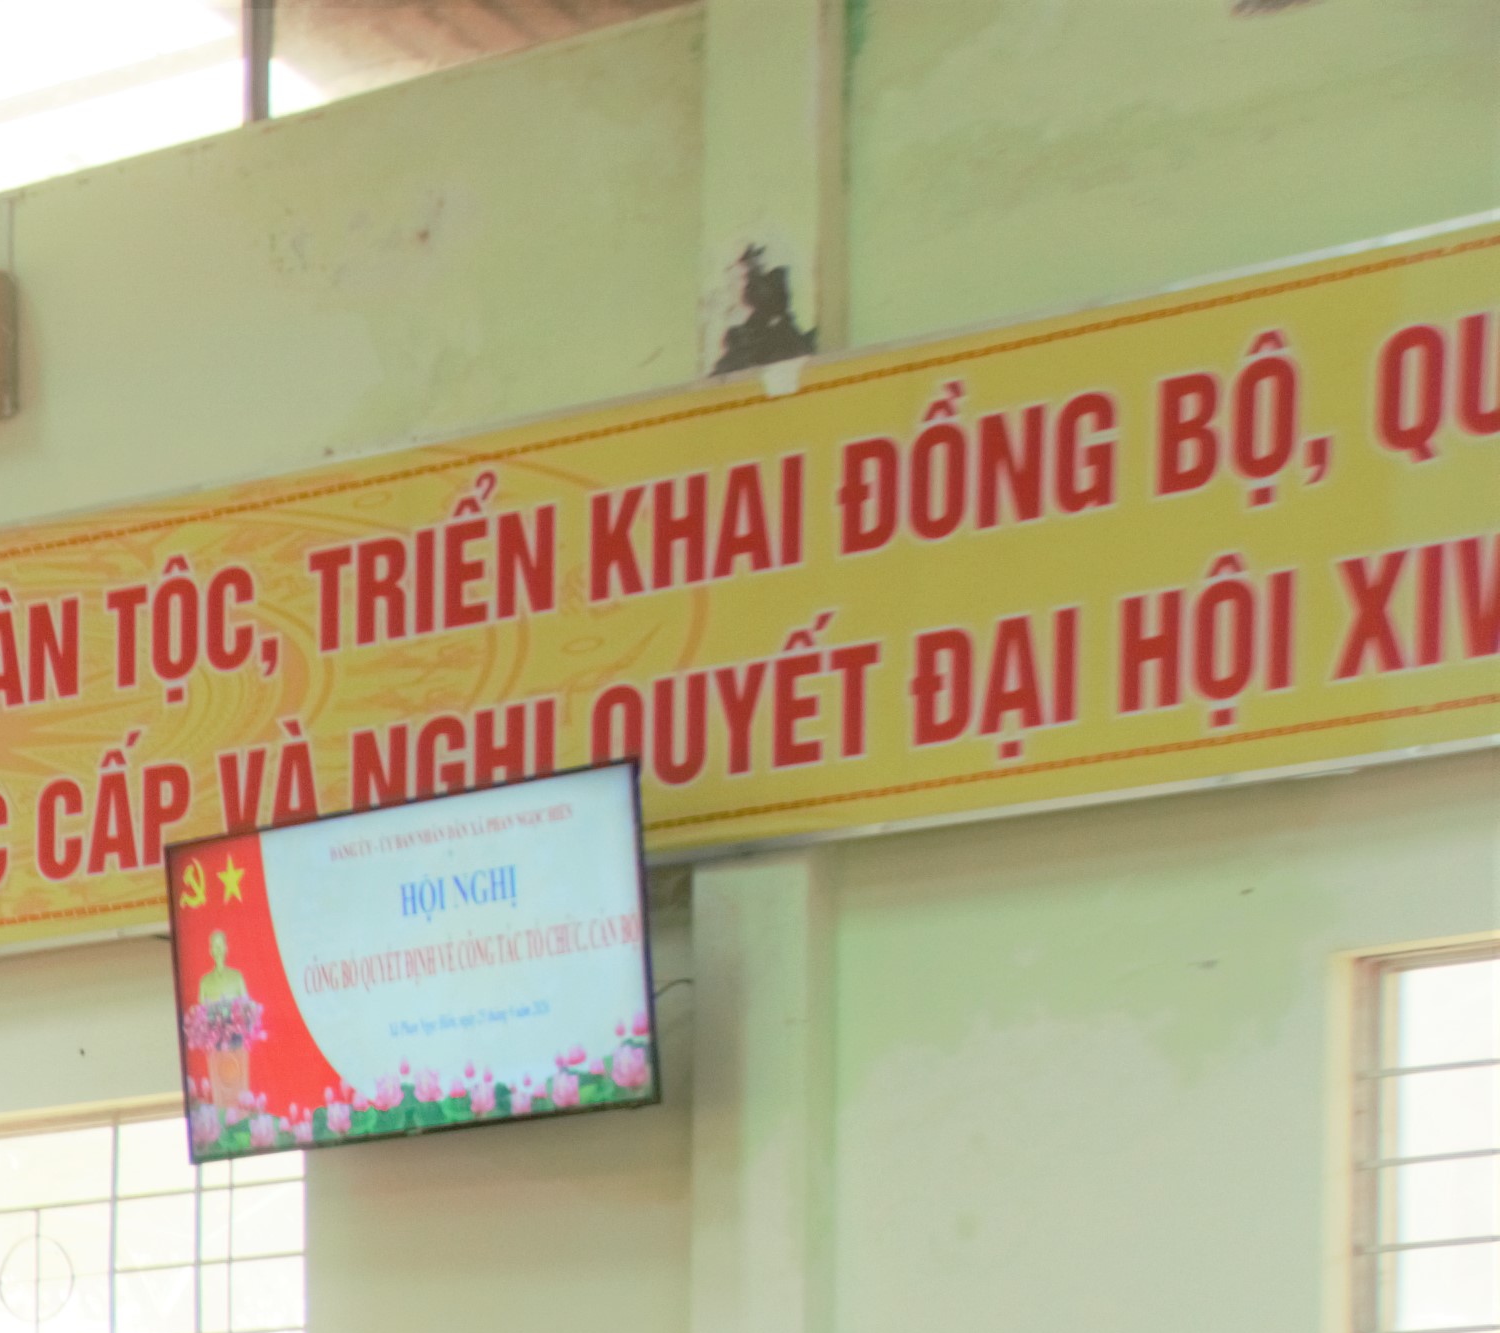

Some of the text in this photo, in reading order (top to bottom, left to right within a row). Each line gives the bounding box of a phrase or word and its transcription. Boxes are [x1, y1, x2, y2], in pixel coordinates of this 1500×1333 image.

[105, 554, 280, 704] TỘC,
[309, 470, 555, 652] TRIỂN
[588, 454, 804, 601] KHAI
[837, 378, 1118, 556] ĐỒNG
[1154, 329, 1333, 507] BỘ,
[36, 731, 191, 880] CẤP
[218, 720, 321, 832] VÀ
[589, 610, 879, 786] QUYẾT
[910, 607, 1078, 760] ĐẠI
[1117, 554, 1296, 730] HỘI
[400, 864, 518, 922] HỘI NGHỊ
